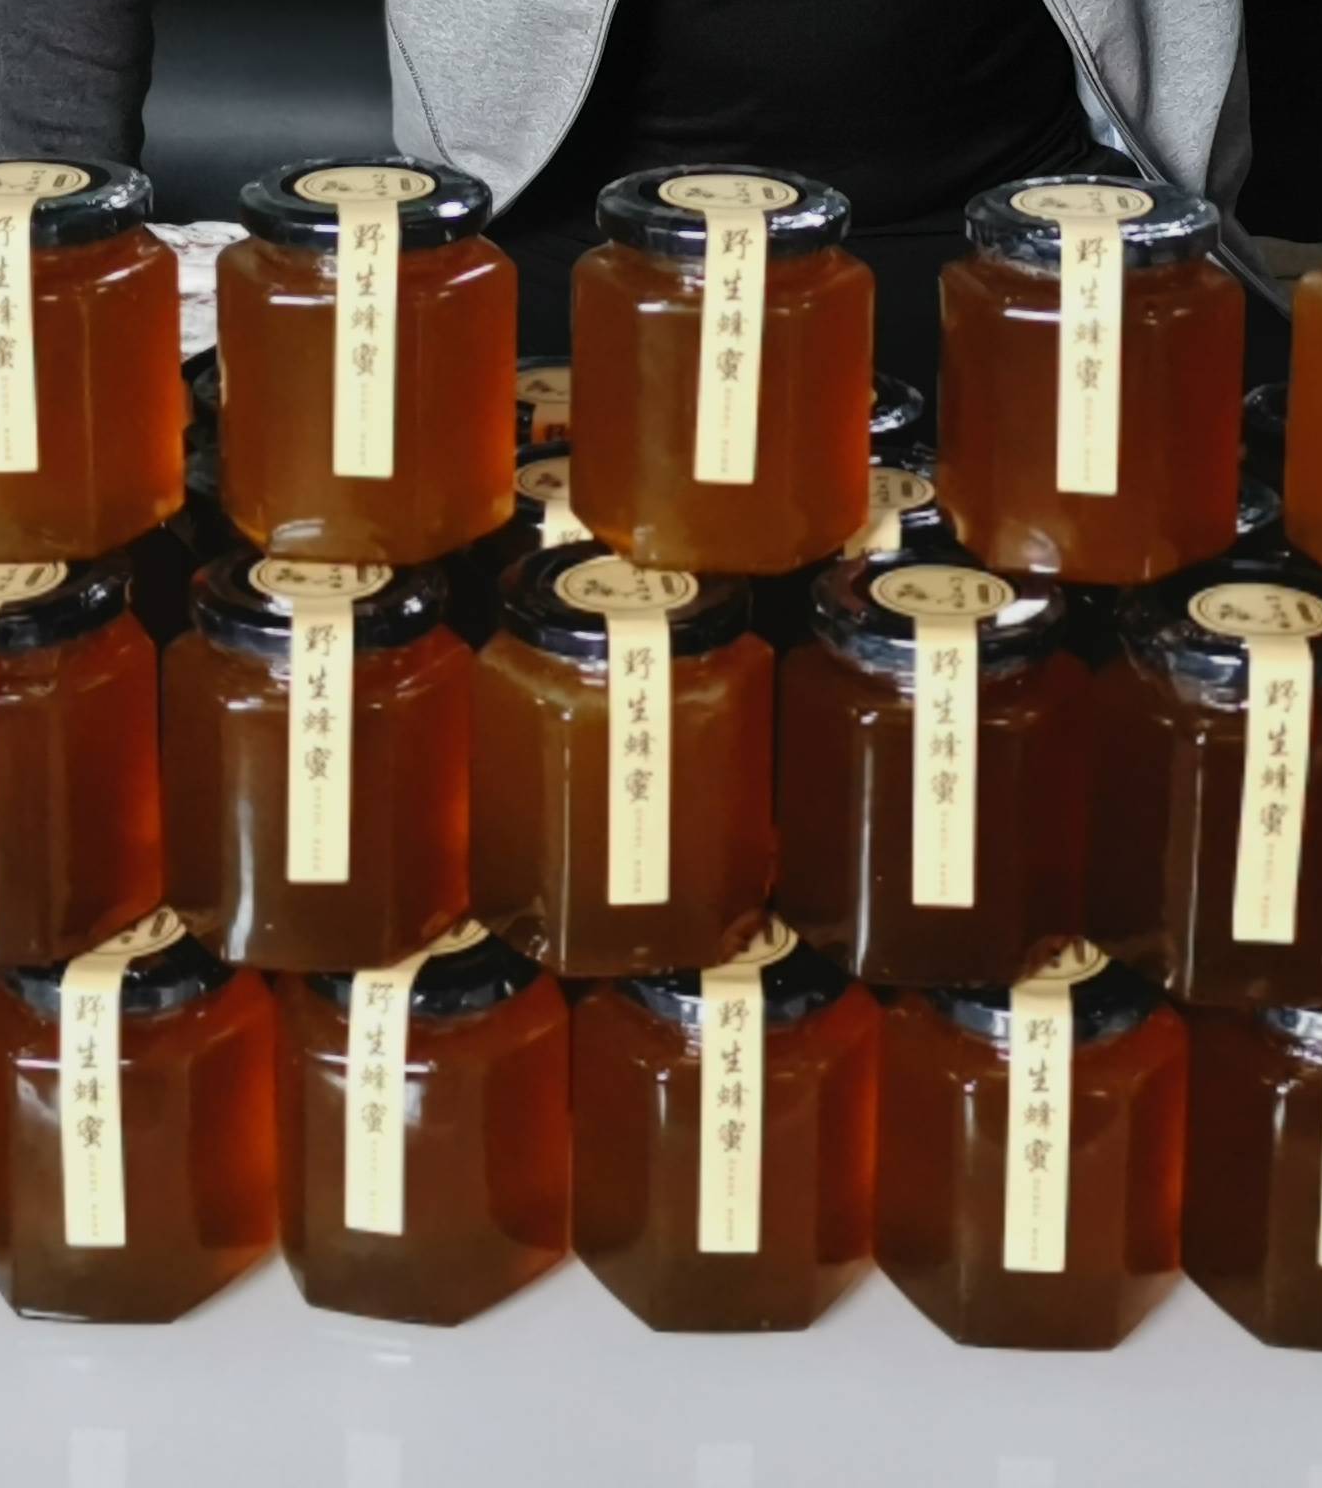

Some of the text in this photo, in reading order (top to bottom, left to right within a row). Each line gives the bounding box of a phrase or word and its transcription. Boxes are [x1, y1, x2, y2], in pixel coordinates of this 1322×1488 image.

[351, 222, 385, 377] 野生蜂蜜
[716, 228, 753, 383] 野生蜂蜜
[1072, 236, 1107, 391] 野生蜂蜜
[304, 623, 339, 782] 野生蜂蜜
[623, 648, 656, 805] 野生蜂蜜
[930, 648, 963, 806] 野生蜂蜜
[1260, 680, 1297, 839] 野生蜂蜜
[73, 995, 106, 1151] 野生蜂蜜
[360, 981, 394, 1134] 野生蜂蜜
[717, 999, 750, 1153] 野生蜂蜜
[1024, 1018, 1057, 1173] 野生蜂蜜
